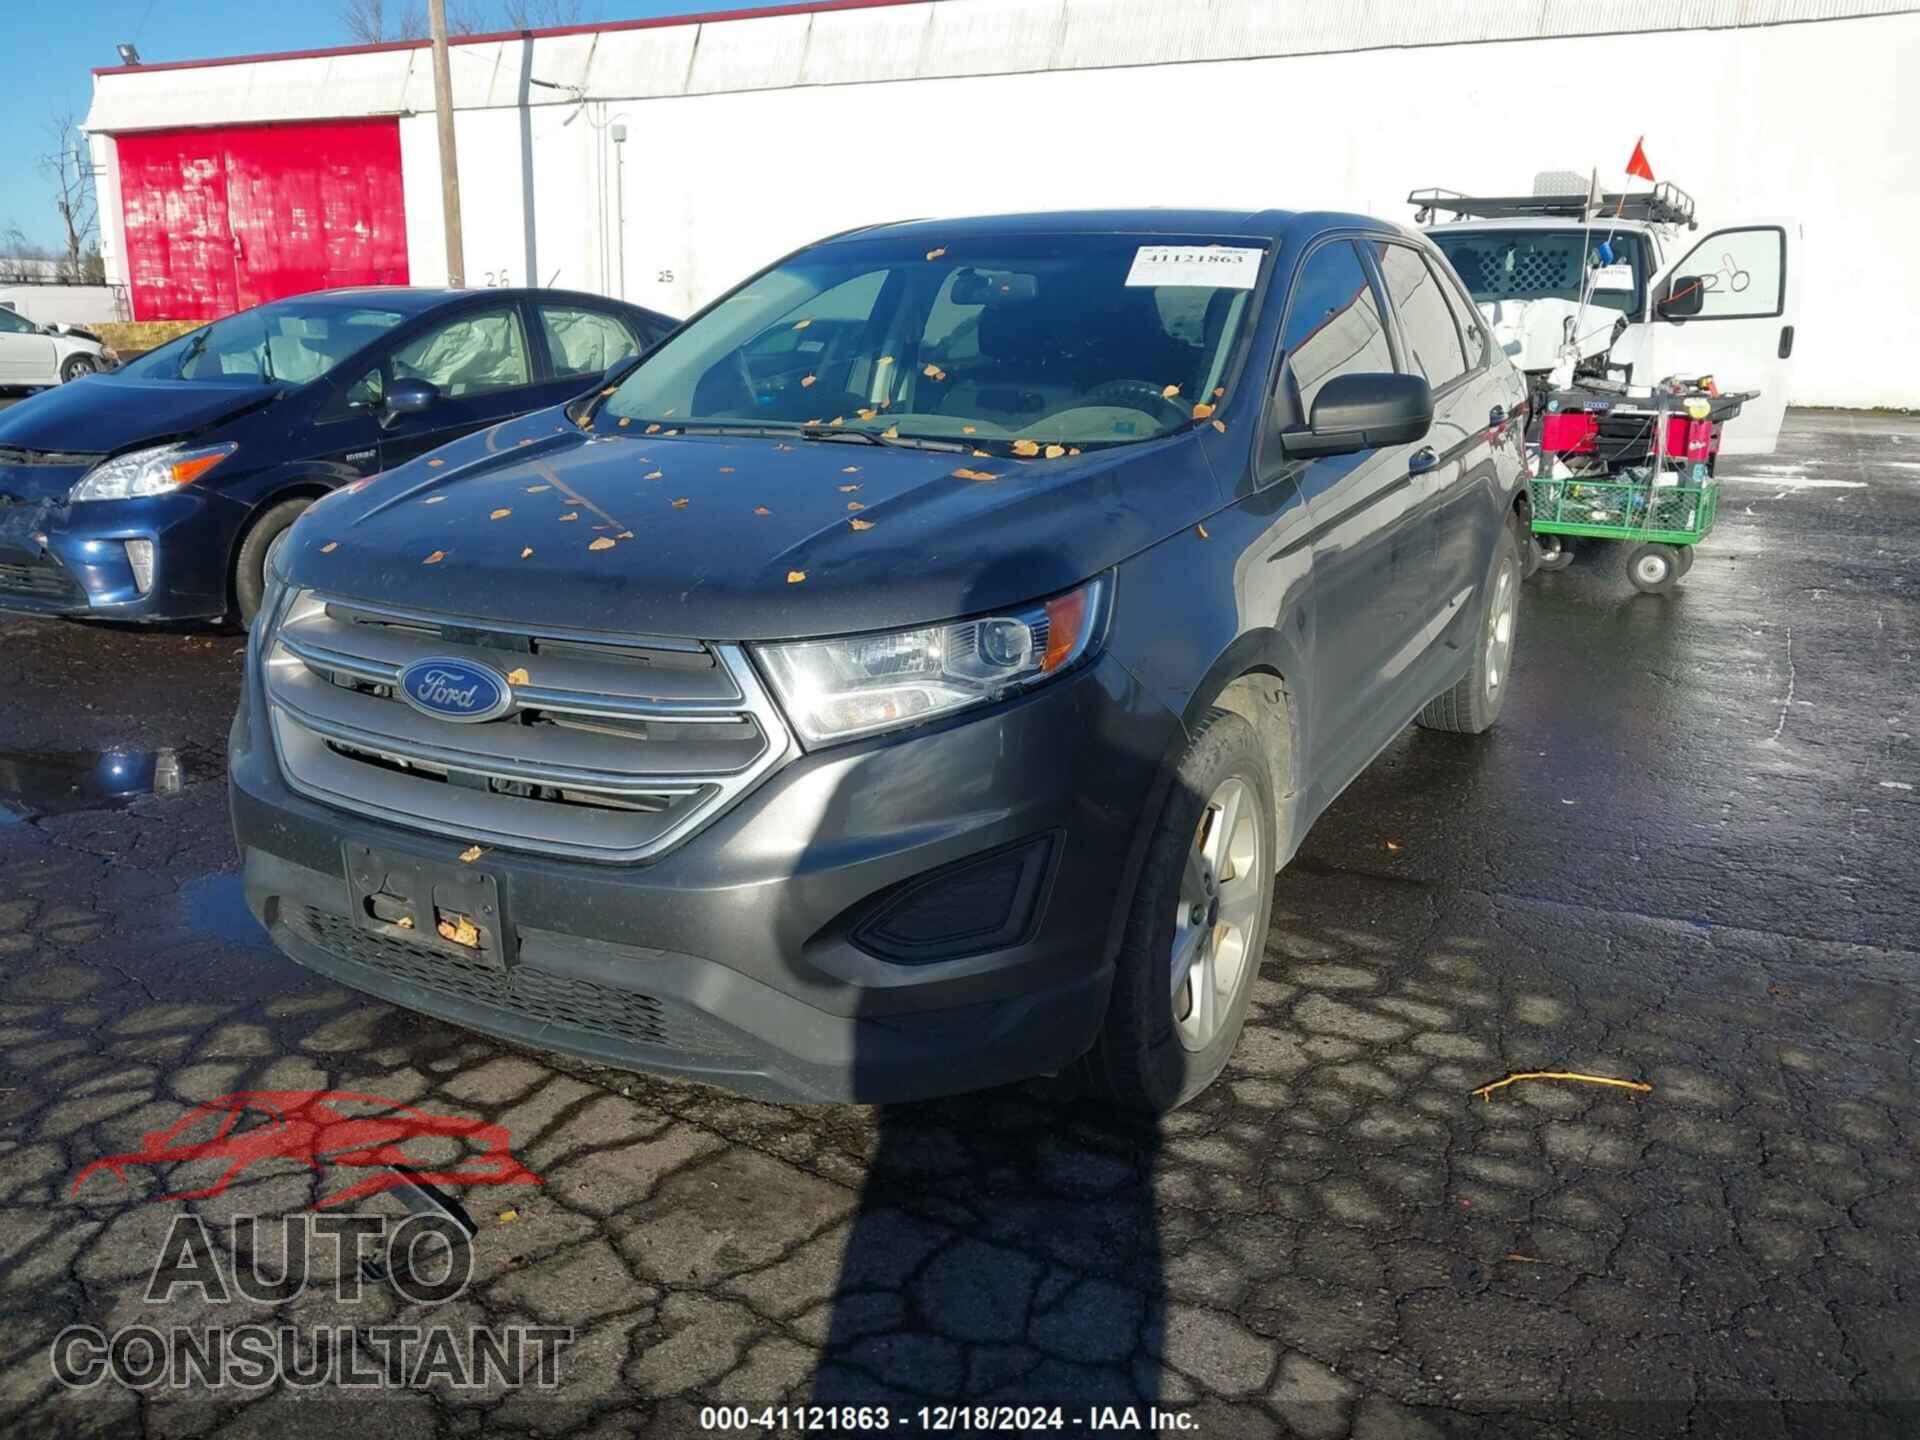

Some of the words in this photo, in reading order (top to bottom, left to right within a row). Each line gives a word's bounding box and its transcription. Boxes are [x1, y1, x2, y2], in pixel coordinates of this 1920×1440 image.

[1144, 254, 1244, 264] 41121863
[484, 268, 511, 288] 26
[656, 269, 675, 284] 25
[416, 669, 478, 708] Ford
